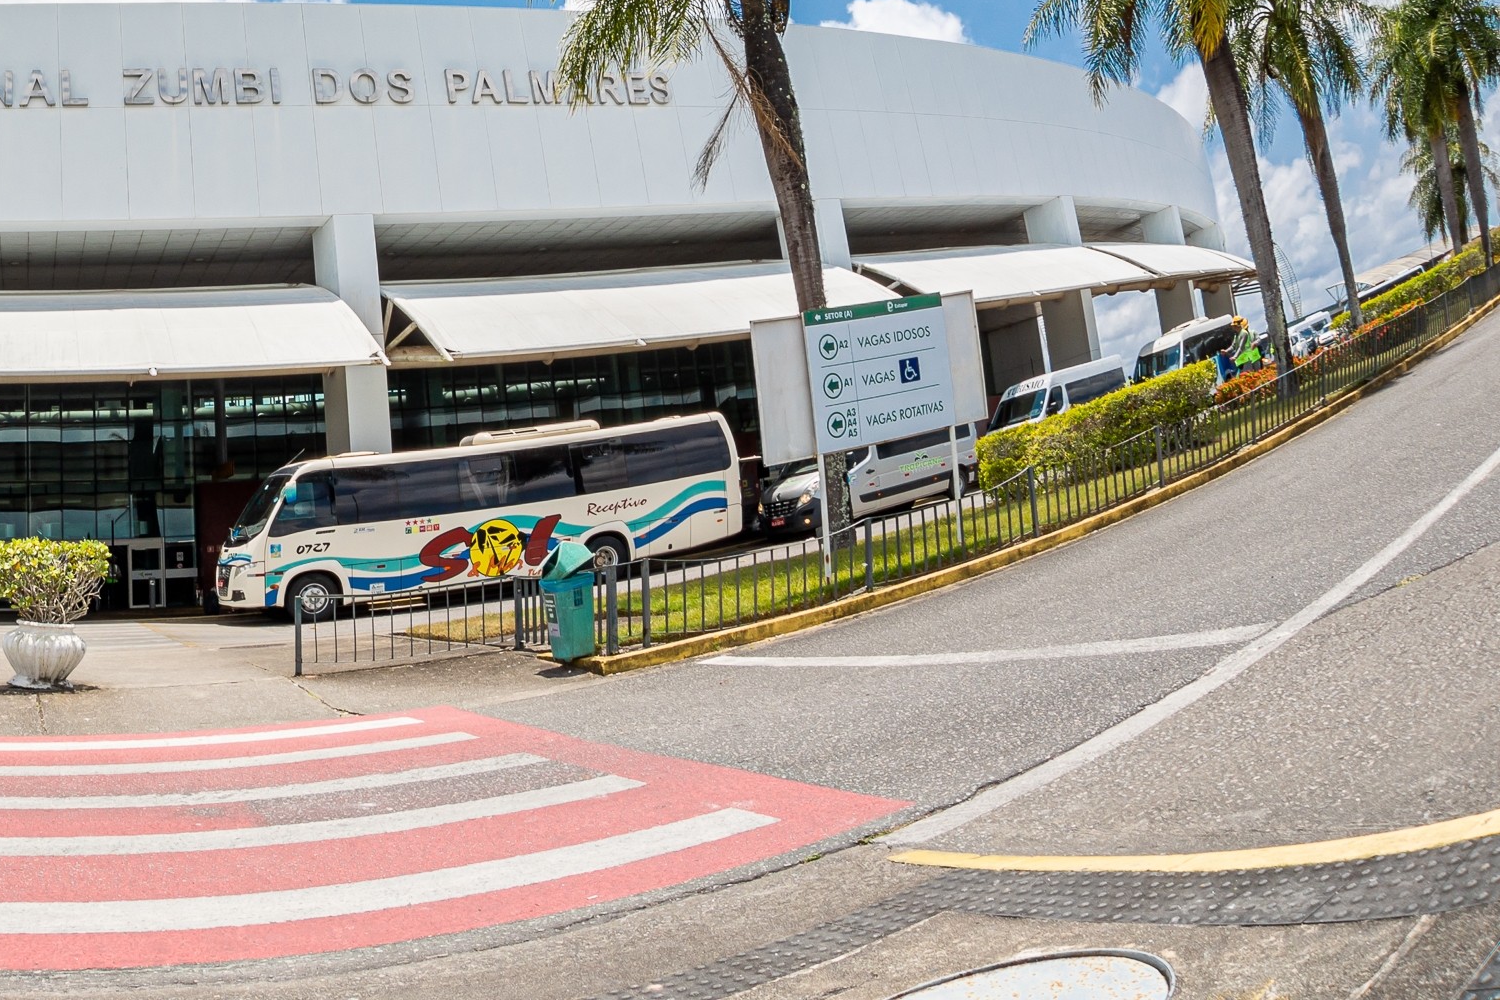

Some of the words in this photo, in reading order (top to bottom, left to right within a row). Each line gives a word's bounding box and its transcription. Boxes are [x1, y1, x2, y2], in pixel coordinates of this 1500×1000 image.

[123, 67, 281, 105] ZUMBI
[311, 67, 416, 105] DOS
[824, 312, 843, 321] SETOR
[844, 310, 853, 319] (A)
[839, 340, 849, 349] A2
[857, 332, 891, 348] VAGAS
[893, 326, 931, 342] IDOSOS
[844, 377, 853, 387] A1
[862, 370, 896, 386] VAGAS
[846, 408, 857, 418] A3
[866, 410, 897, 426] VAGAS
[900, 401, 944, 420] ROTATIVAS
[847, 418, 857, 428] A4
[848, 429, 858, 438] A5
[587, 498, 648, 516] Receptivo
[296, 542, 331, 555] 0727
